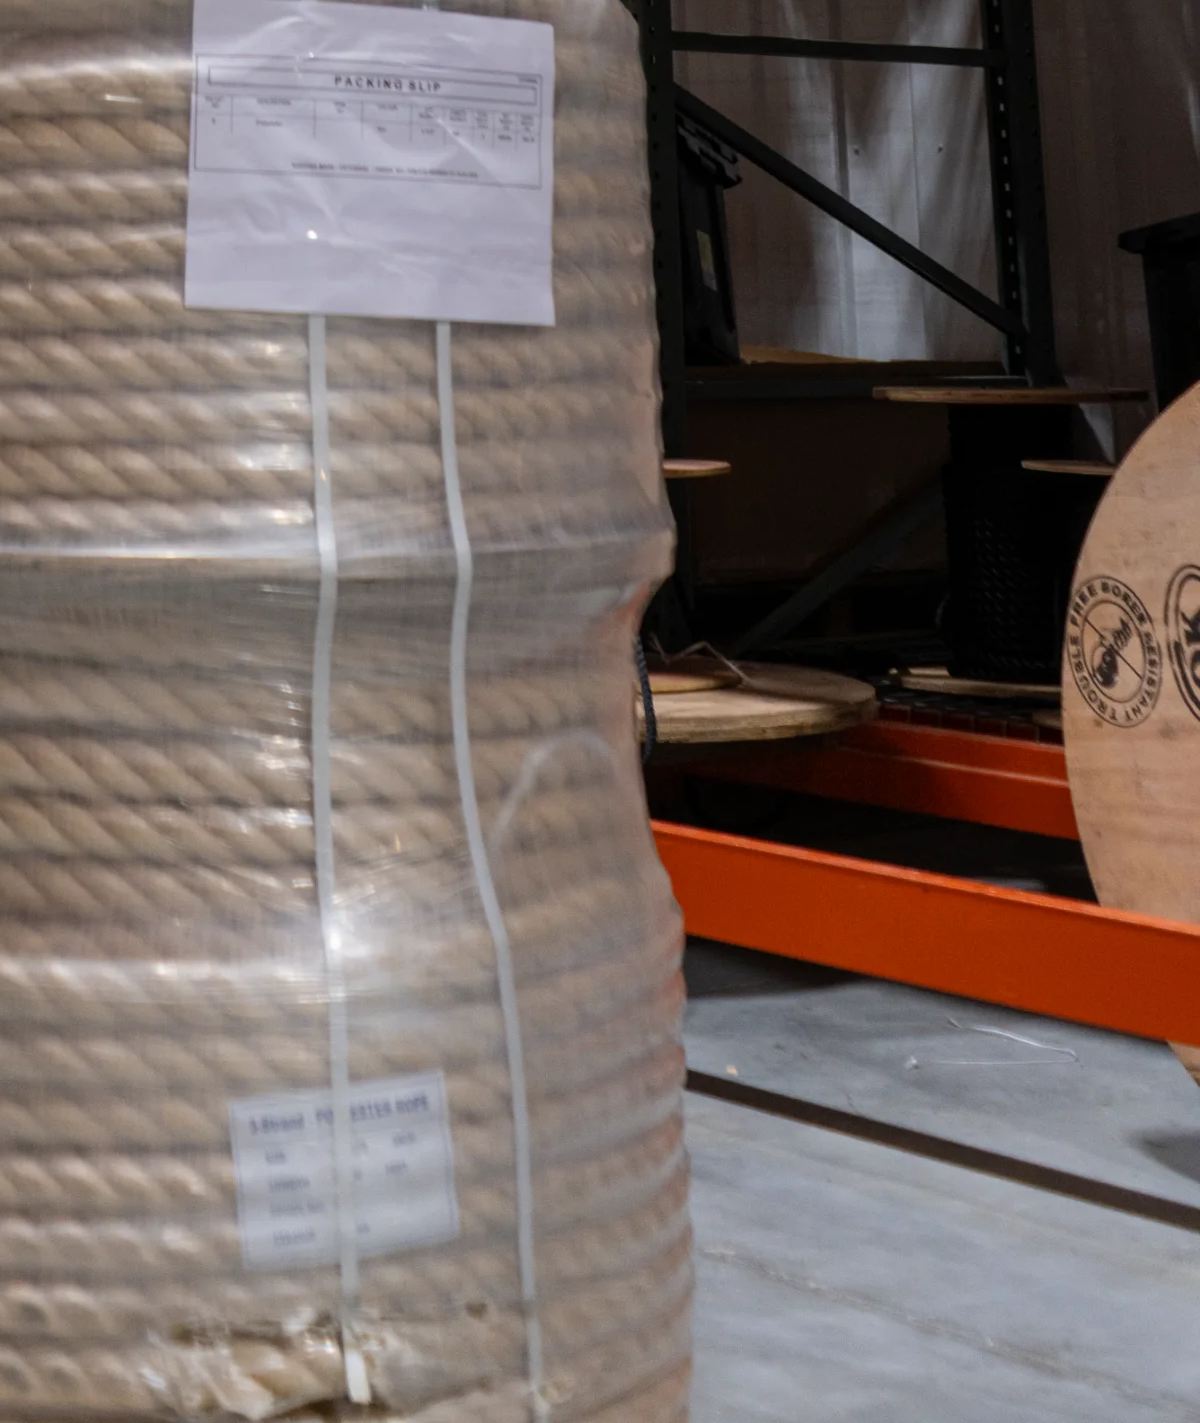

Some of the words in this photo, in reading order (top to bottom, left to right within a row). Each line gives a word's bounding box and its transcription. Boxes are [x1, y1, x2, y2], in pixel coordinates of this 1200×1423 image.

[334, 76, 403, 91] PACKING
[408, 81, 442, 93] SLIP
[1070, 583, 1098, 627] FREE
[1069, 635, 1119, 721] TROUBLE
[1124, 631, 1157, 721] RESISTANT
[315, 1097, 394, 1126] POESTER
